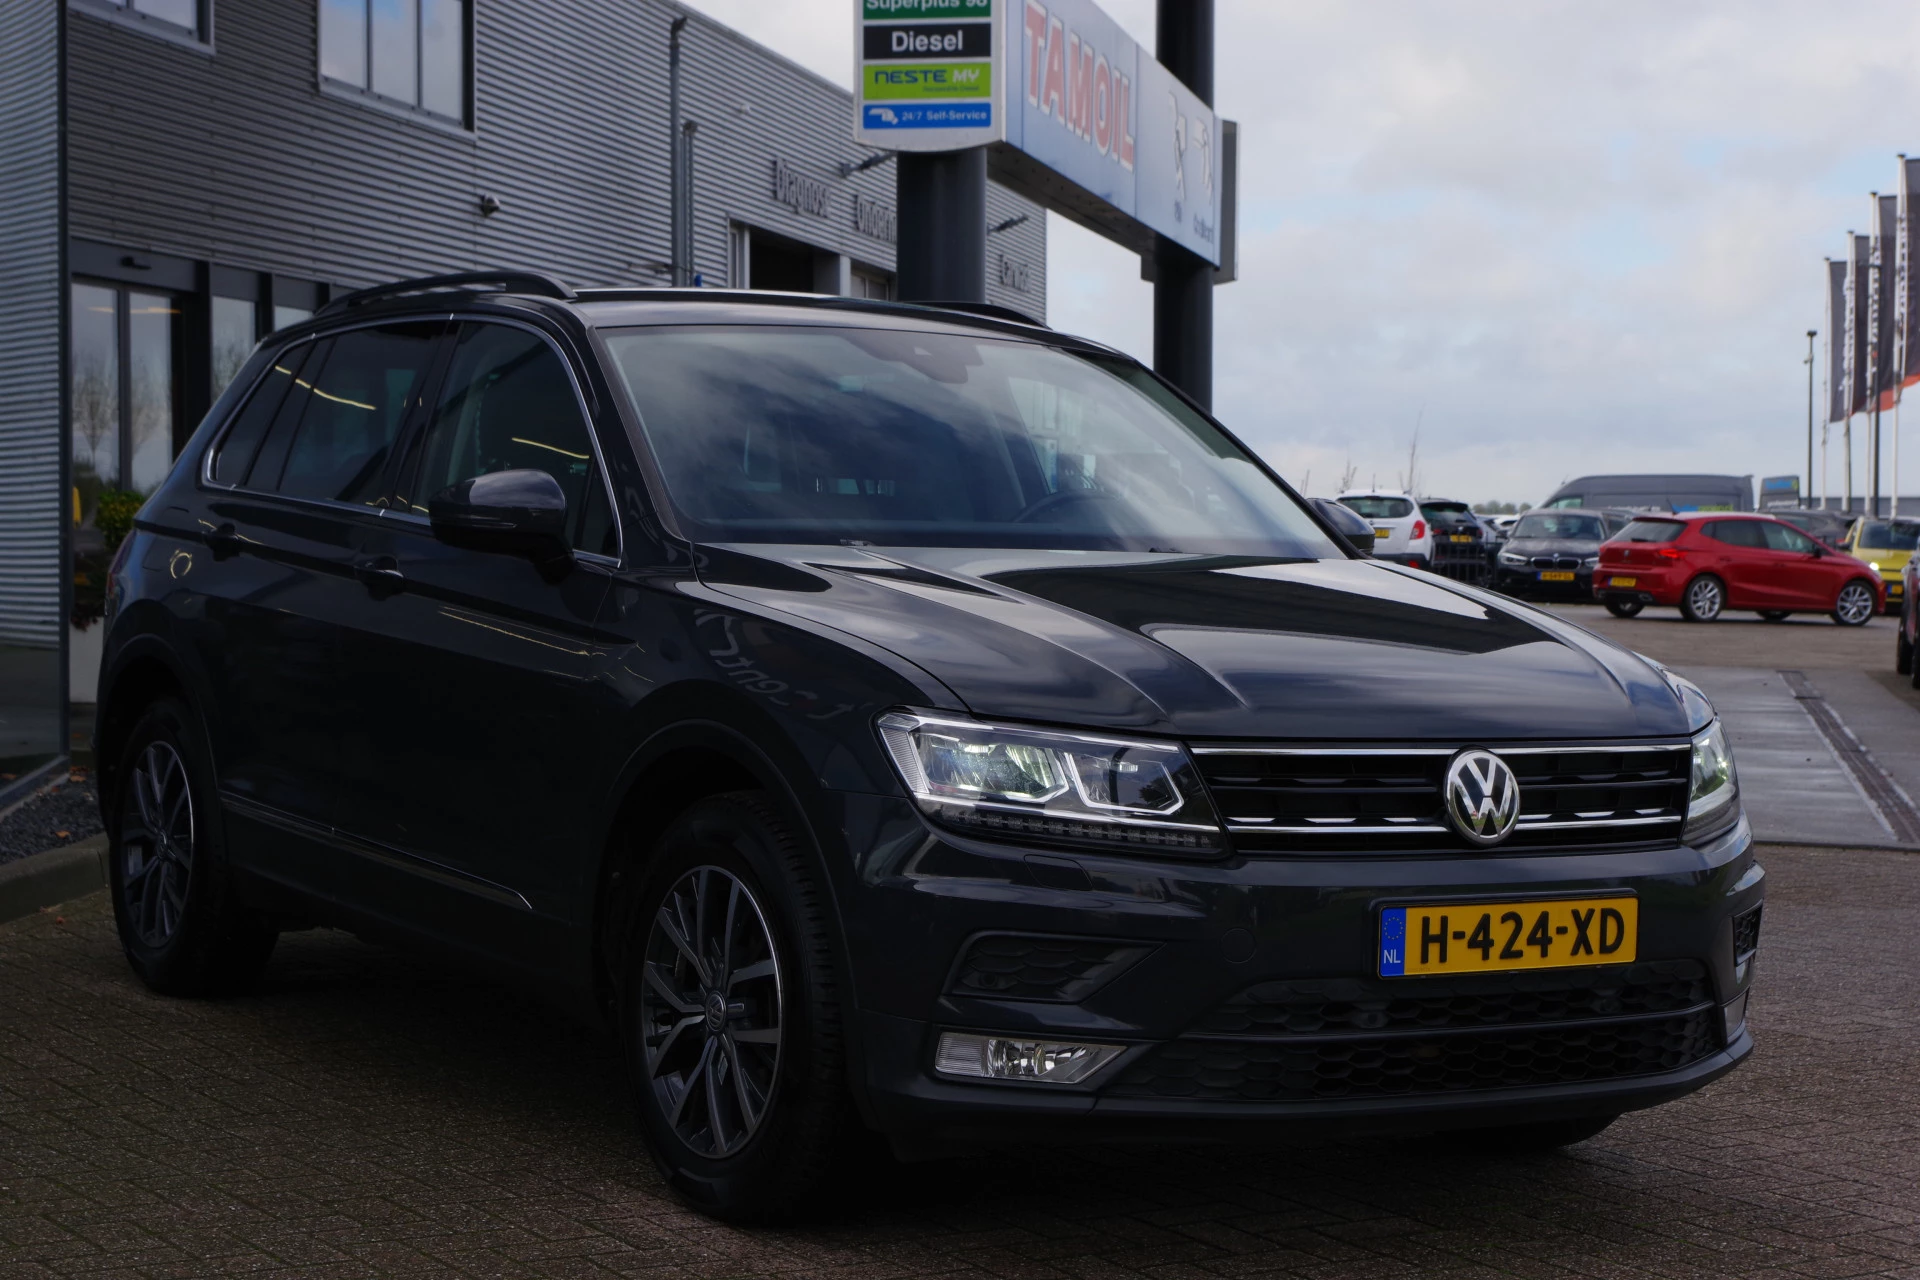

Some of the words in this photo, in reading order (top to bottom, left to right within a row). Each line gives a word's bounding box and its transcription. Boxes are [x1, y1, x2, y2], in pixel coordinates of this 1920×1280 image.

[891, 29, 964, 53] Diesel
[952, 68, 980, 84] MY
[1025, 0, 1134, 174] TAMOIL
[902, 111, 922, 121] 24/7
[926, 109, 988, 121] Self-Service
[1419, 907, 1625, 965] H-424-XD
[1382, 948, 1402, 965] NL
